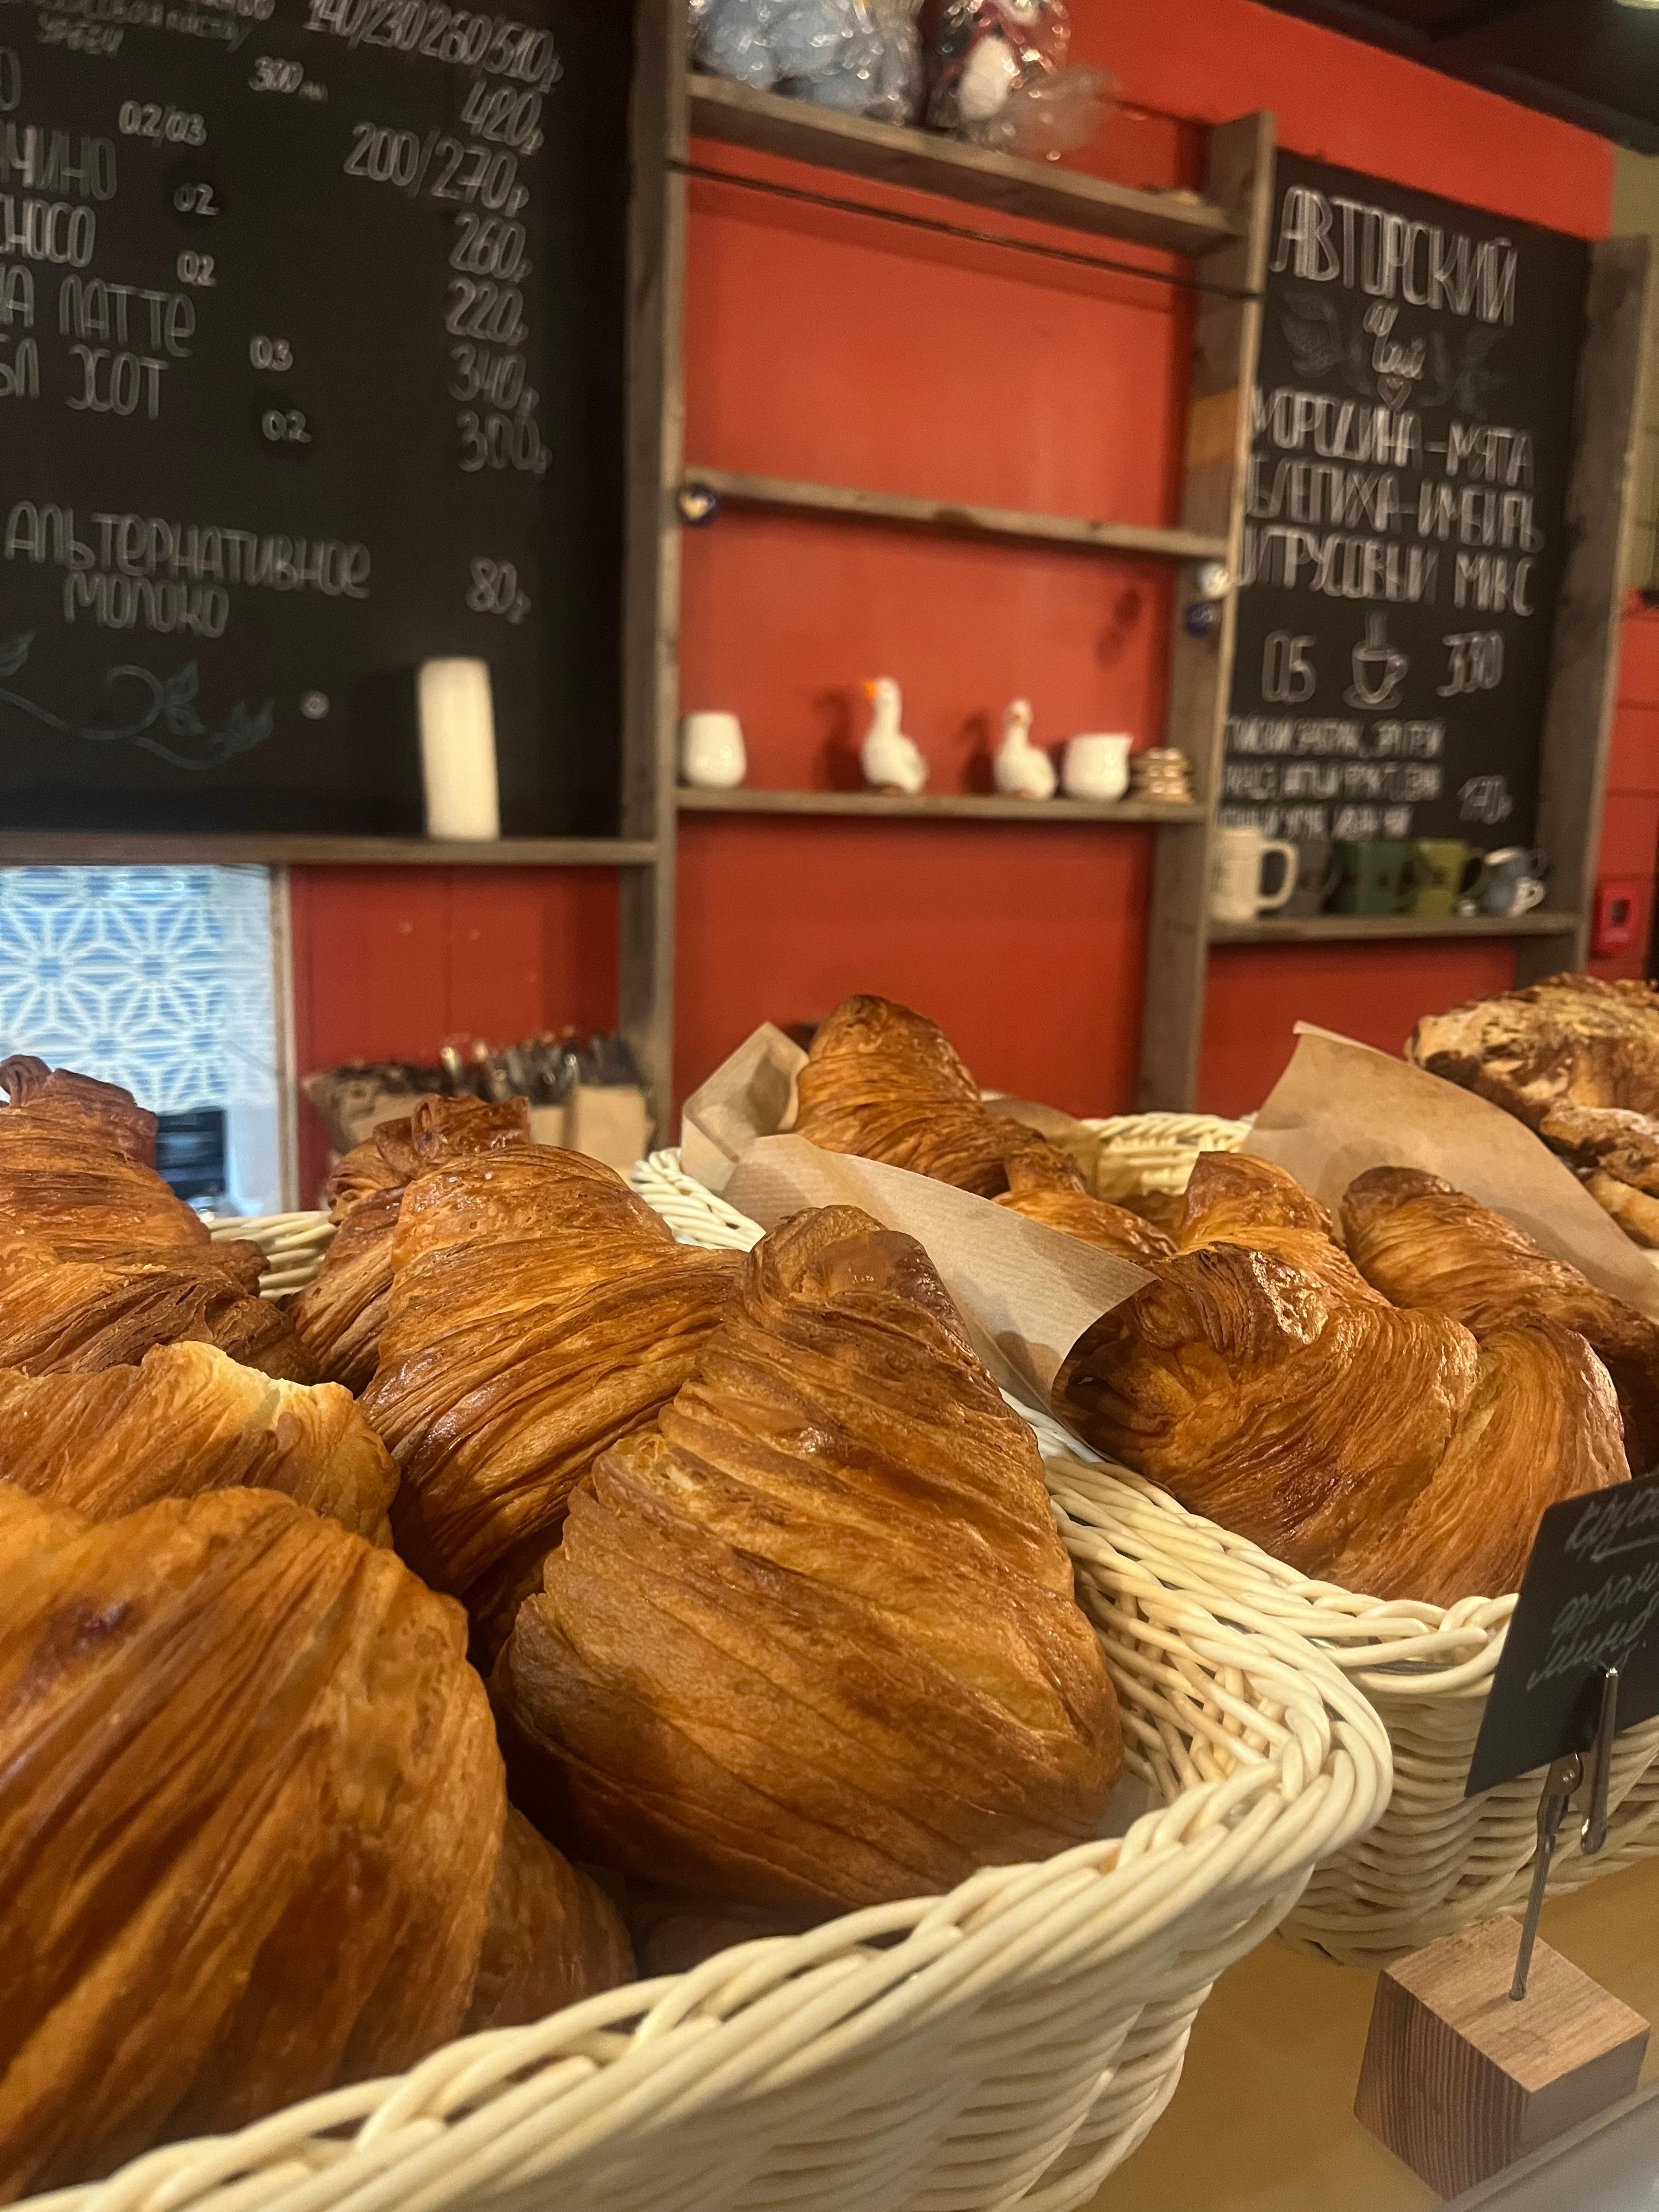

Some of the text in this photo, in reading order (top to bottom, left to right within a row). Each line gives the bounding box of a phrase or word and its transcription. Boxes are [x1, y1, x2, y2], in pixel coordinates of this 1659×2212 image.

[1250, 386, 1536, 488] МОРОДИНА-МЯТА
[1245, 454, 1546, 553] БЛЕПИХА-ИМБИРЬ
[63, 568, 230, 639] МОЛОКО
